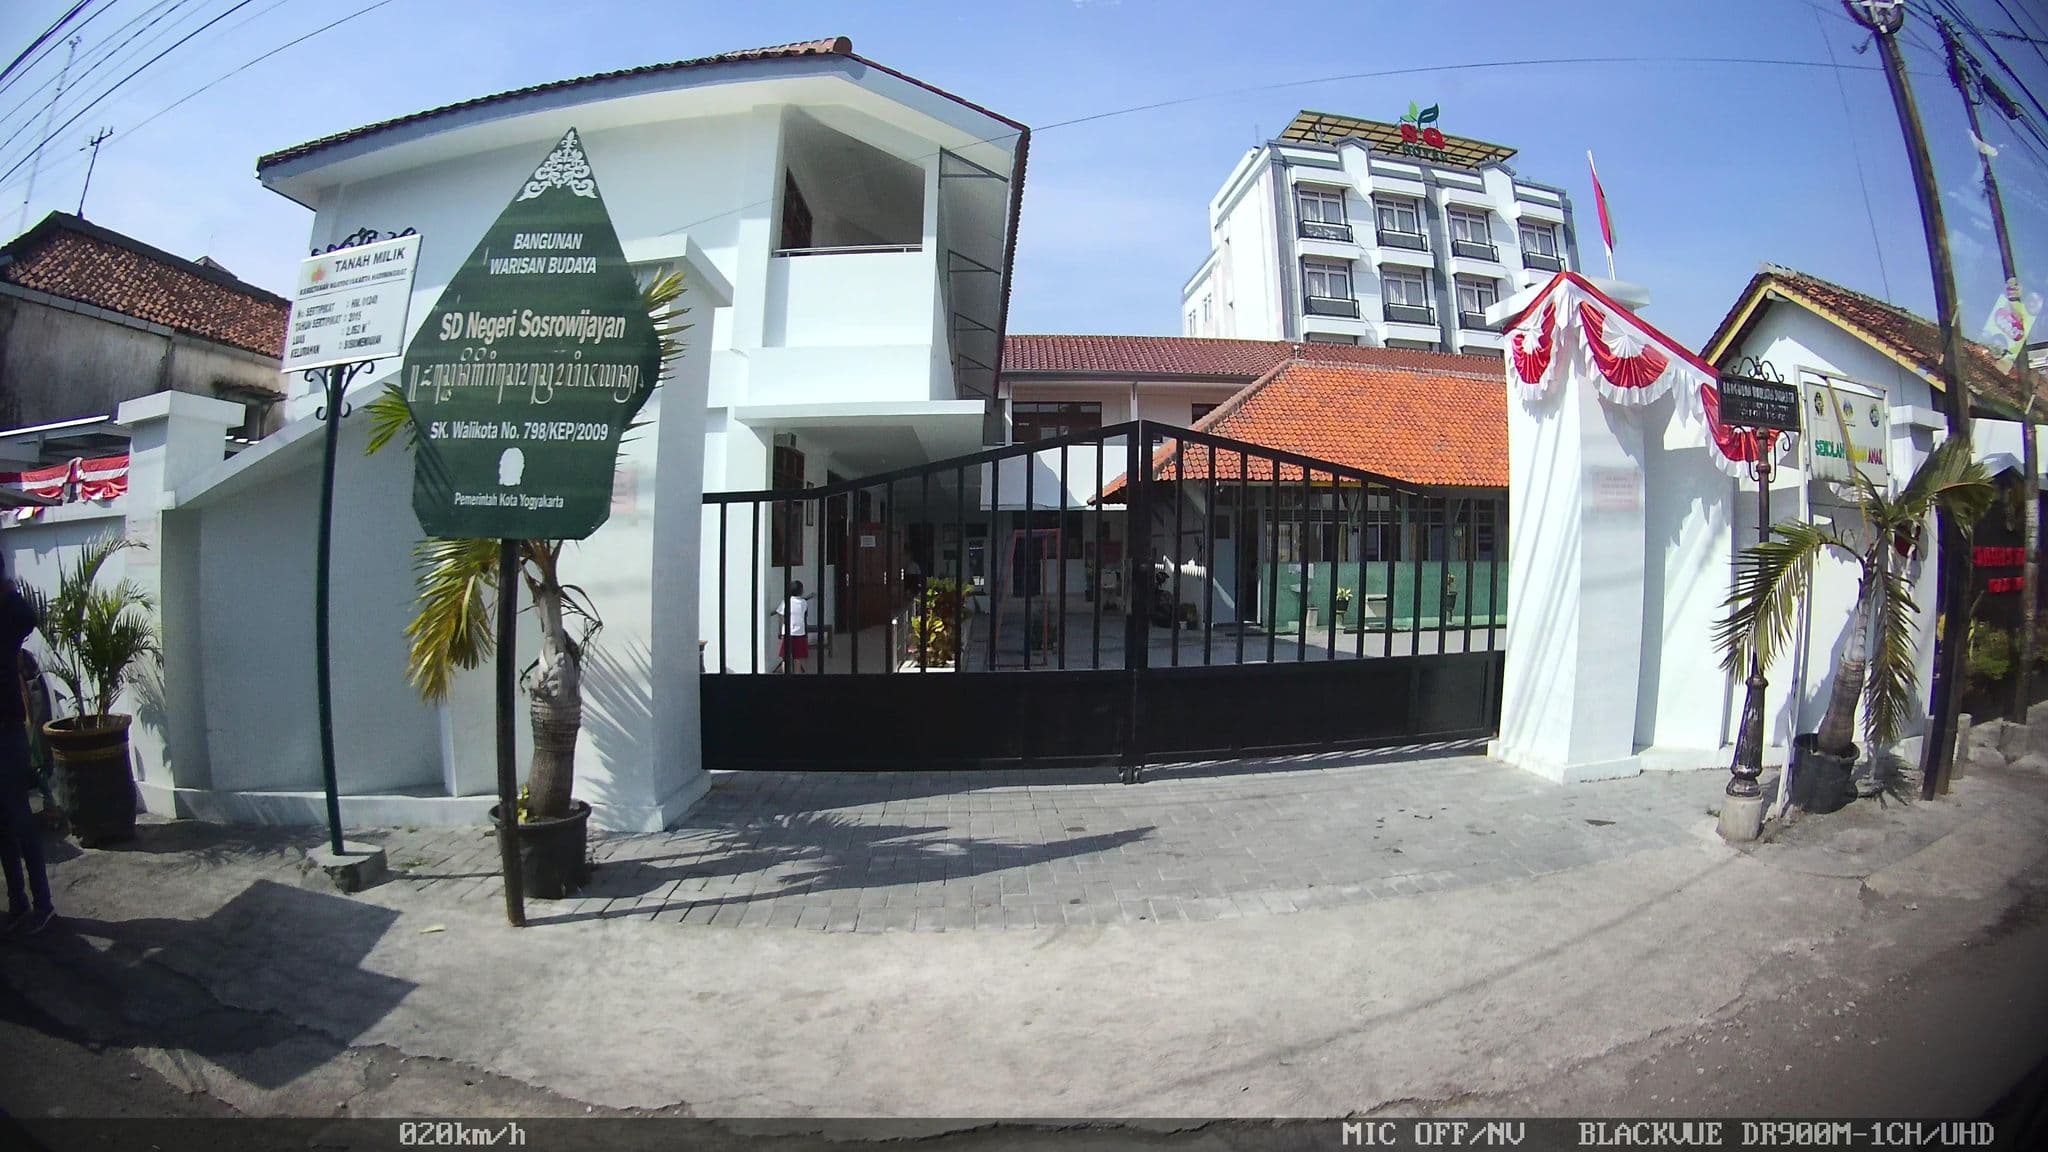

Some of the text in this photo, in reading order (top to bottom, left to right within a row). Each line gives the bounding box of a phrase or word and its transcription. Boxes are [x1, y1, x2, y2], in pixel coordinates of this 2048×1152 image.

[513, 232, 583, 250] BANGUNAN
[335, 246, 406, 272] TANAH MILIK
[490, 256, 597, 275] WARISAN BUDAYA
[439, 309, 627, 345] SD Negeri Sosrowijayan
[430, 421, 608, 442] SK. Walikota No. 798/KEP/2009
[454, 491, 564, 510] Pemerintah Kota Yogyakarta
